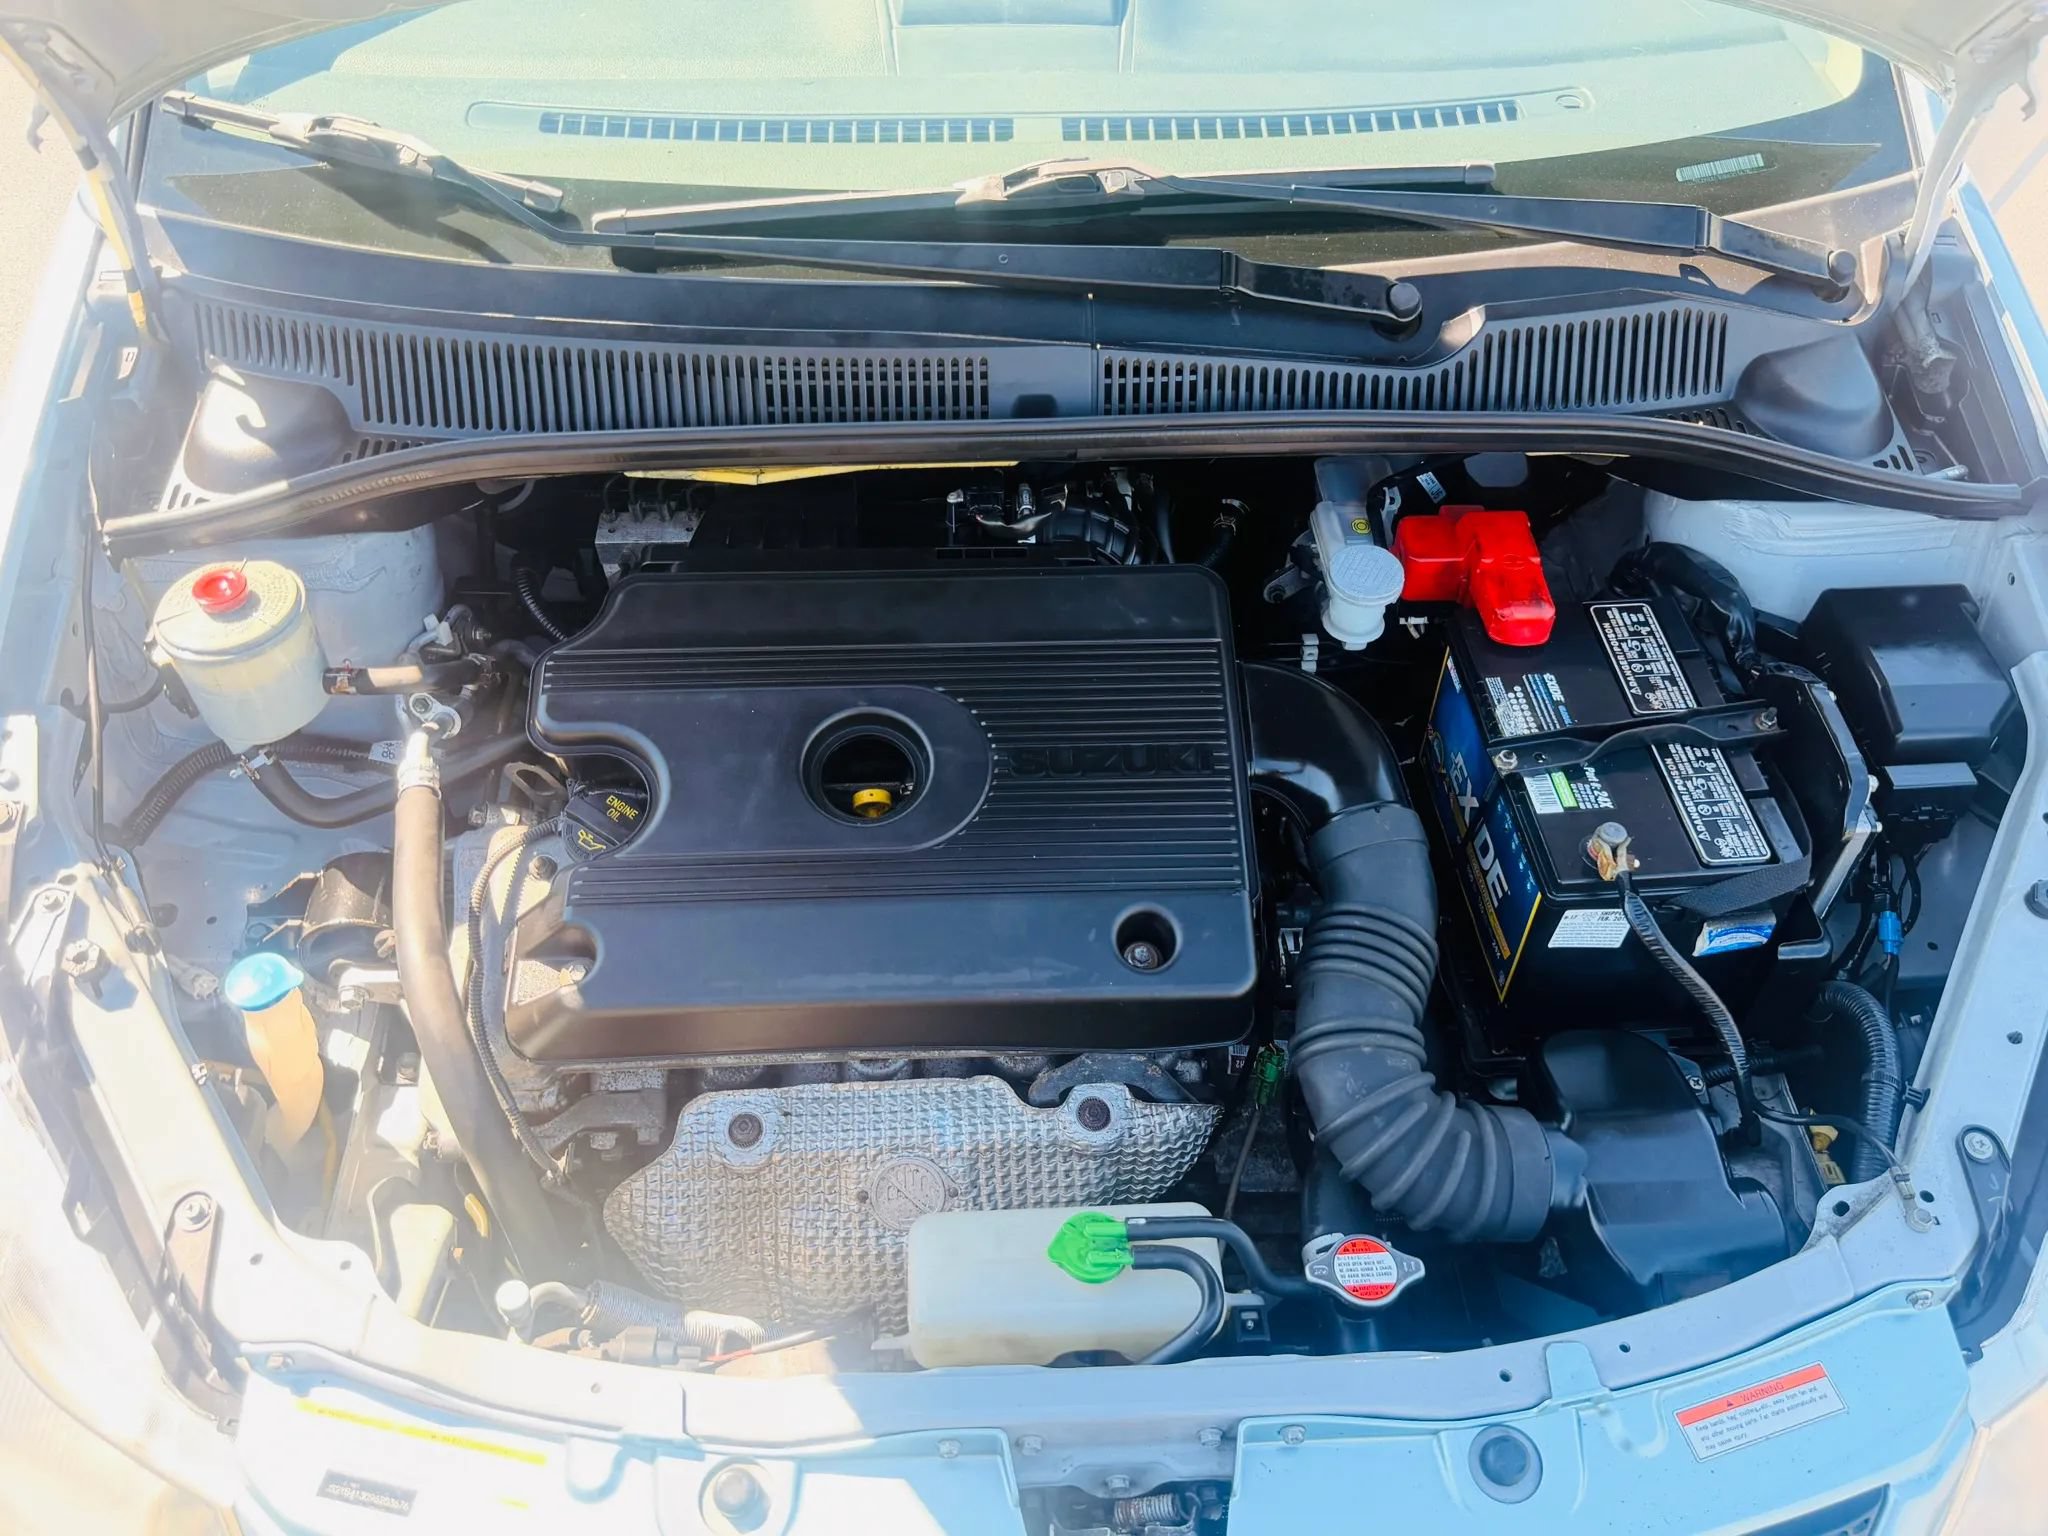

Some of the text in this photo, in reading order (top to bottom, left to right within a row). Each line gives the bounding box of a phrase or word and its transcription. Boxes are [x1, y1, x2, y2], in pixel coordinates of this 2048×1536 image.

[1602, 622, 1637, 686] DANGER/POISON
[1542, 672, 1565, 703] EXIDE
[1009, 742, 1214, 777] SUZUKI
[1583, 766, 1600, 782] Part
[1593, 790, 1614, 808] 24X
[1664, 758, 1706, 831] DANGER/POISON
[606, 795, 639, 820] ENGINE
[606, 808, 619, 822] OIL
[1450, 751, 1508, 908] EXDE
[1740, 1382, 1784, 1402] WARNING
